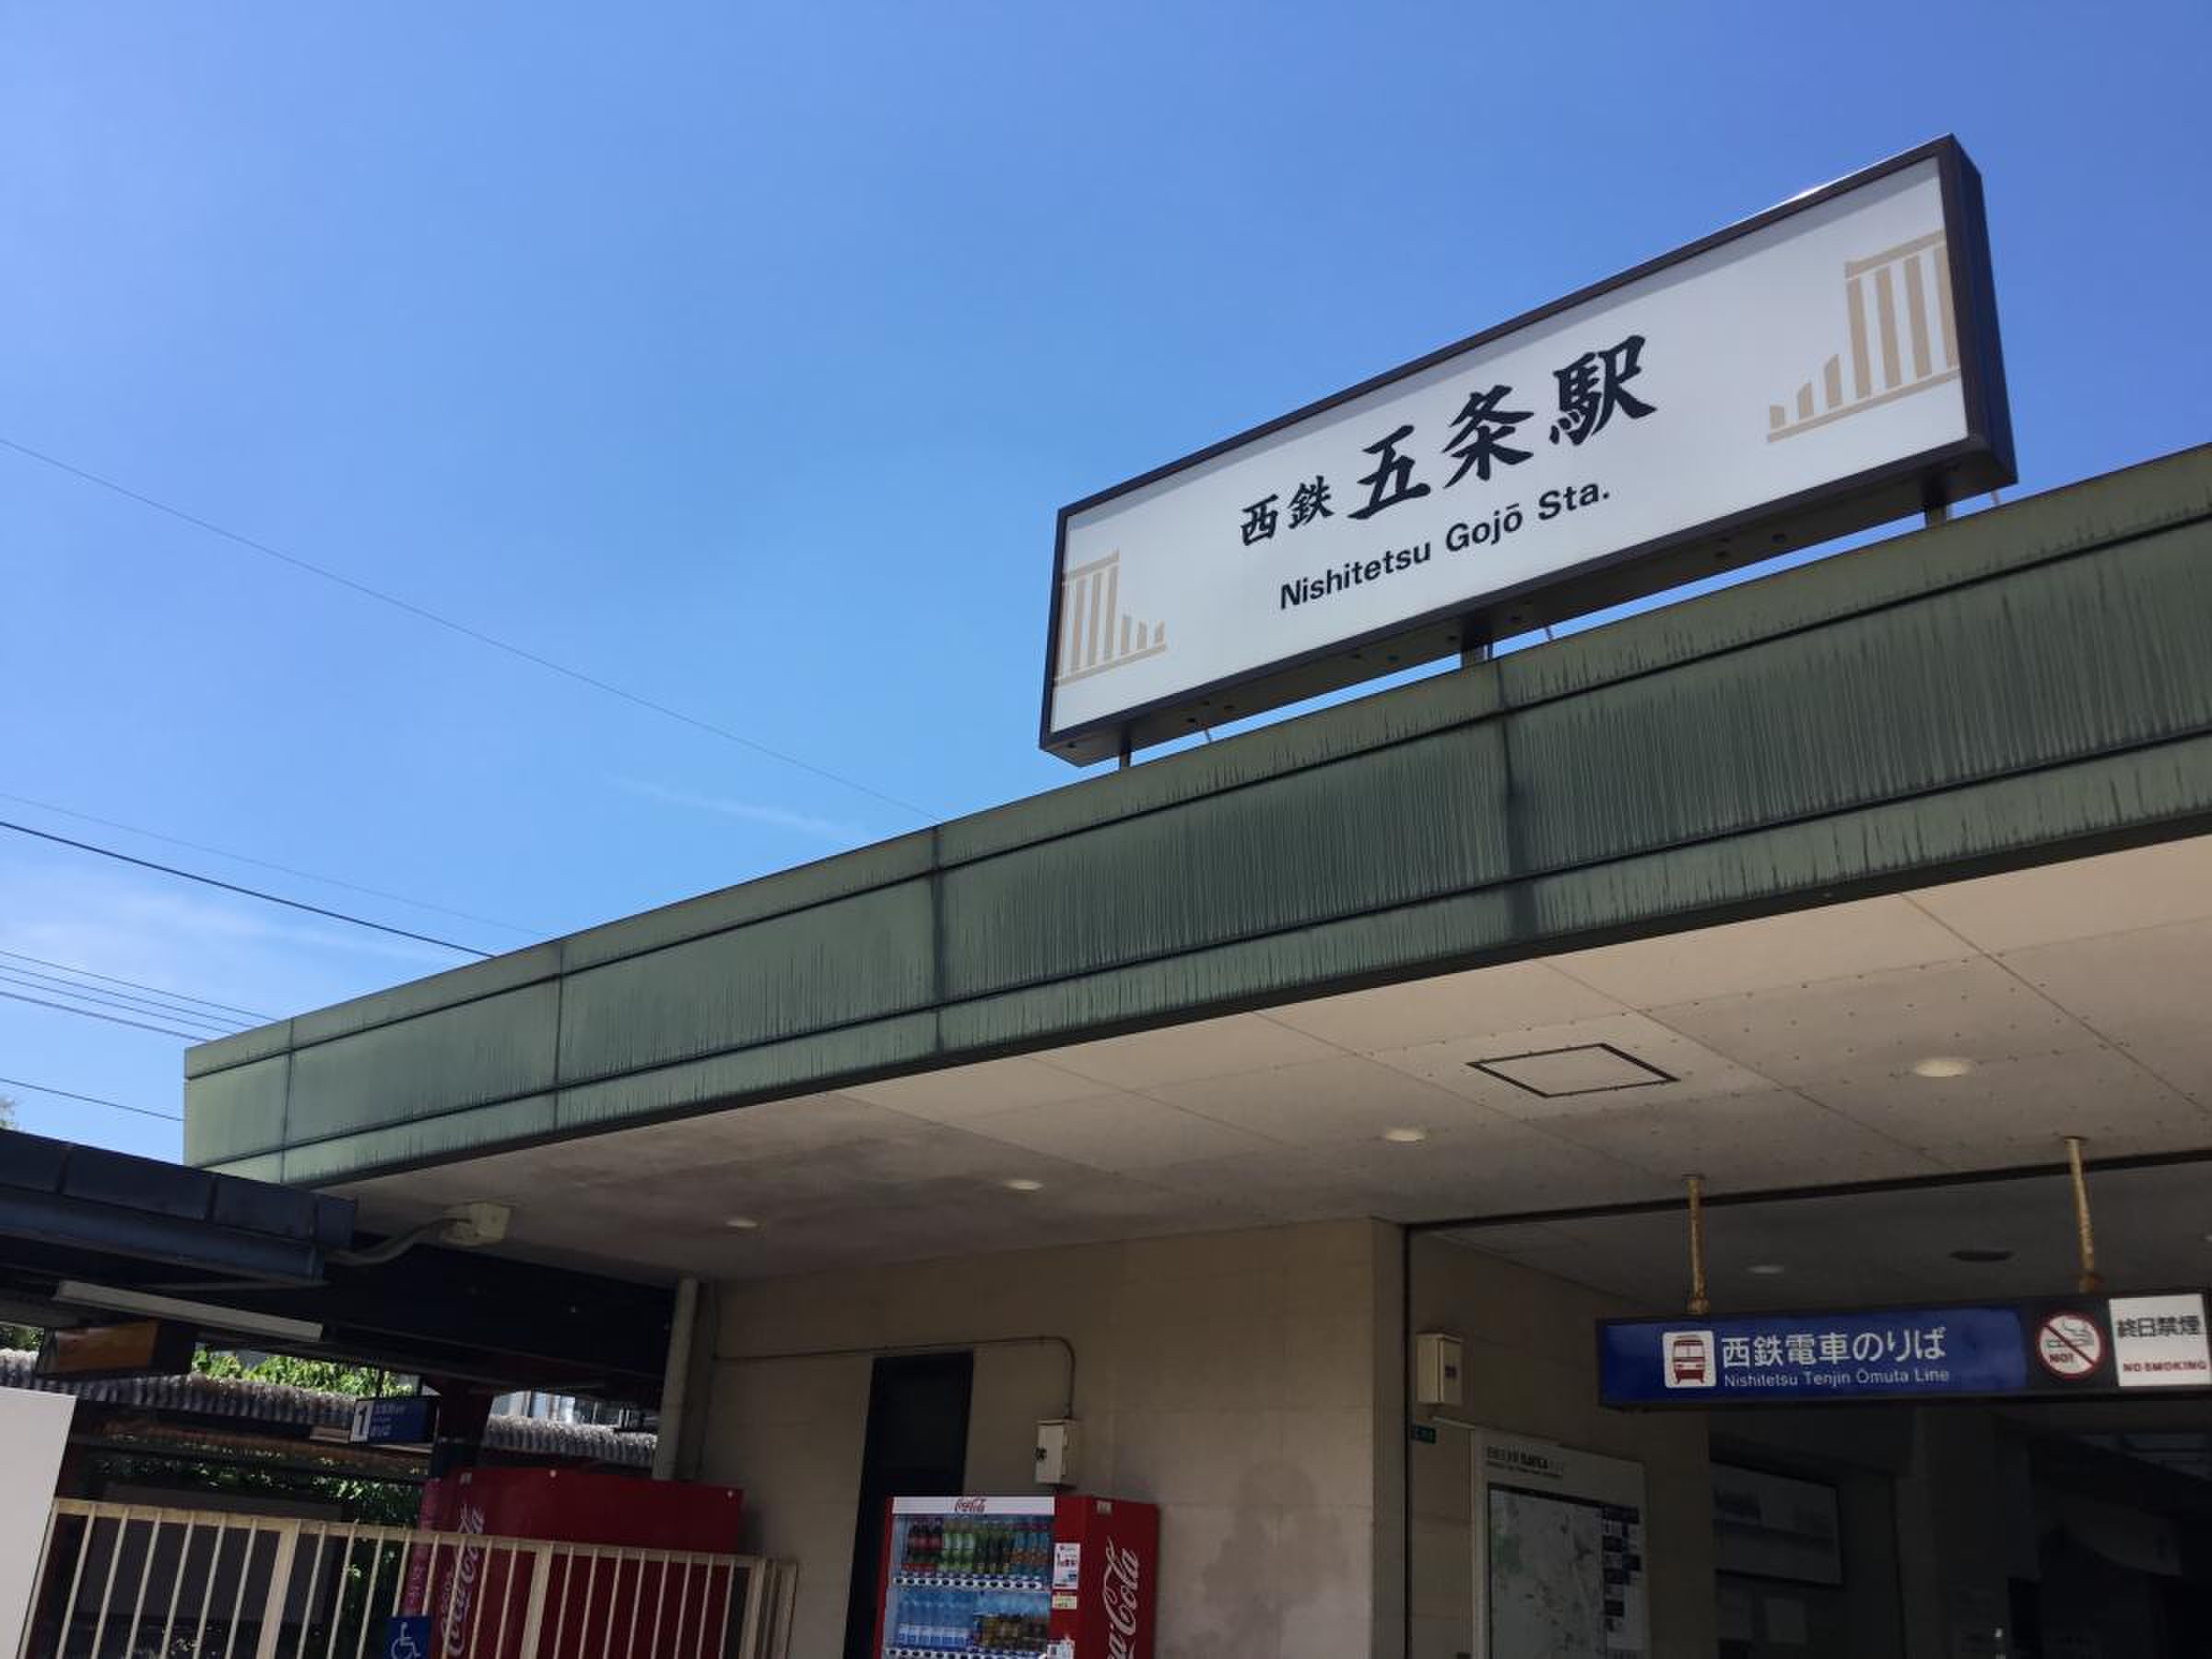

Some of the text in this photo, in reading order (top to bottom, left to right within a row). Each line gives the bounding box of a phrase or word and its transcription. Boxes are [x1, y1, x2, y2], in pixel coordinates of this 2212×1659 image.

[1280, 483, 1609, 610] Nishitetsu Gojō Sta.
[2118, 1315, 2204, 1340] 終日禁煙
[1721, 1326, 1947, 1369] 西鉄電車のりば
[1724, 1373, 1798, 1387] Nishitetsu
[1804, 1371, 1851, 1387] Tenjin
[1913, 1368, 1949, 1382] Line
[2123, 1360, 2207, 1372] NO SMOKING
